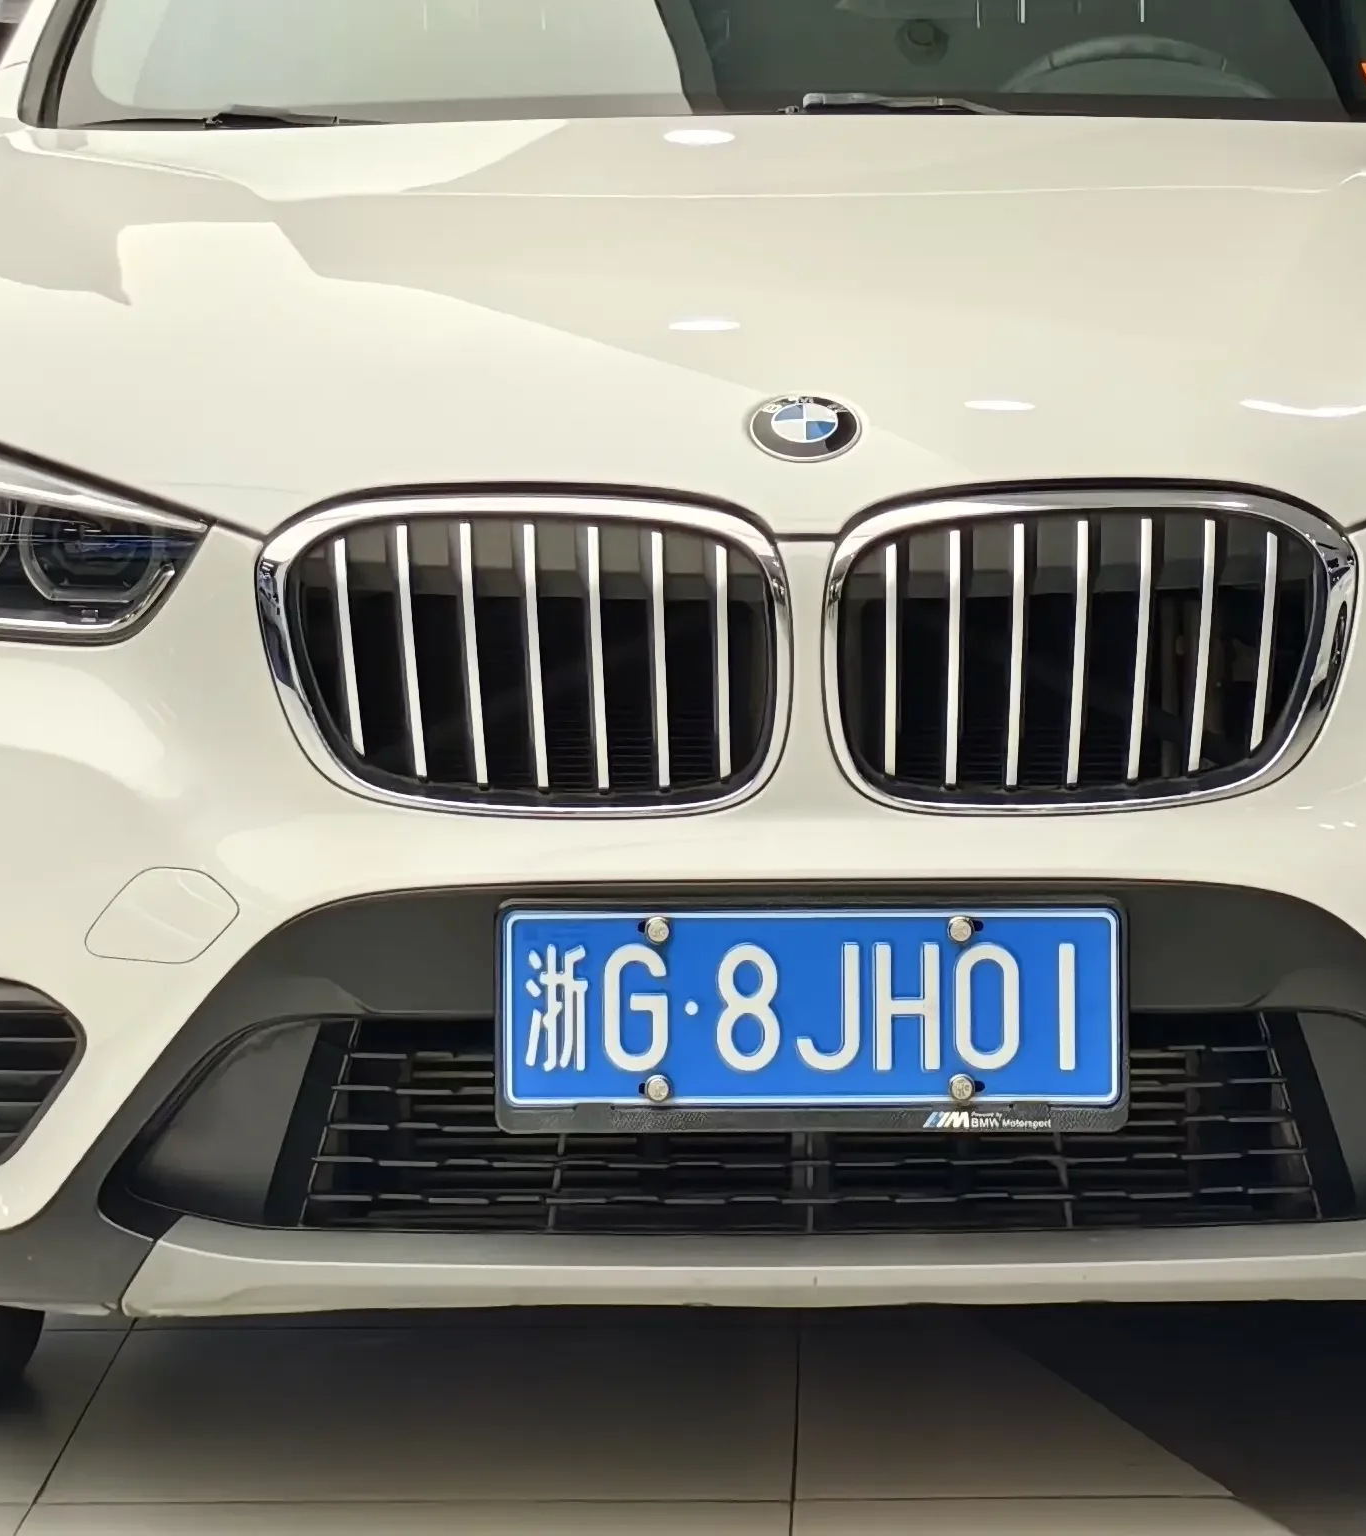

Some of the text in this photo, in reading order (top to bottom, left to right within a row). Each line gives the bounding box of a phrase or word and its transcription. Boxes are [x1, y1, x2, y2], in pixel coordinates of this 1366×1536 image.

[525, 941, 1076, 1072] 浙G·8JH01
[971, 1117, 1052, 1129] BMW Motorsport
